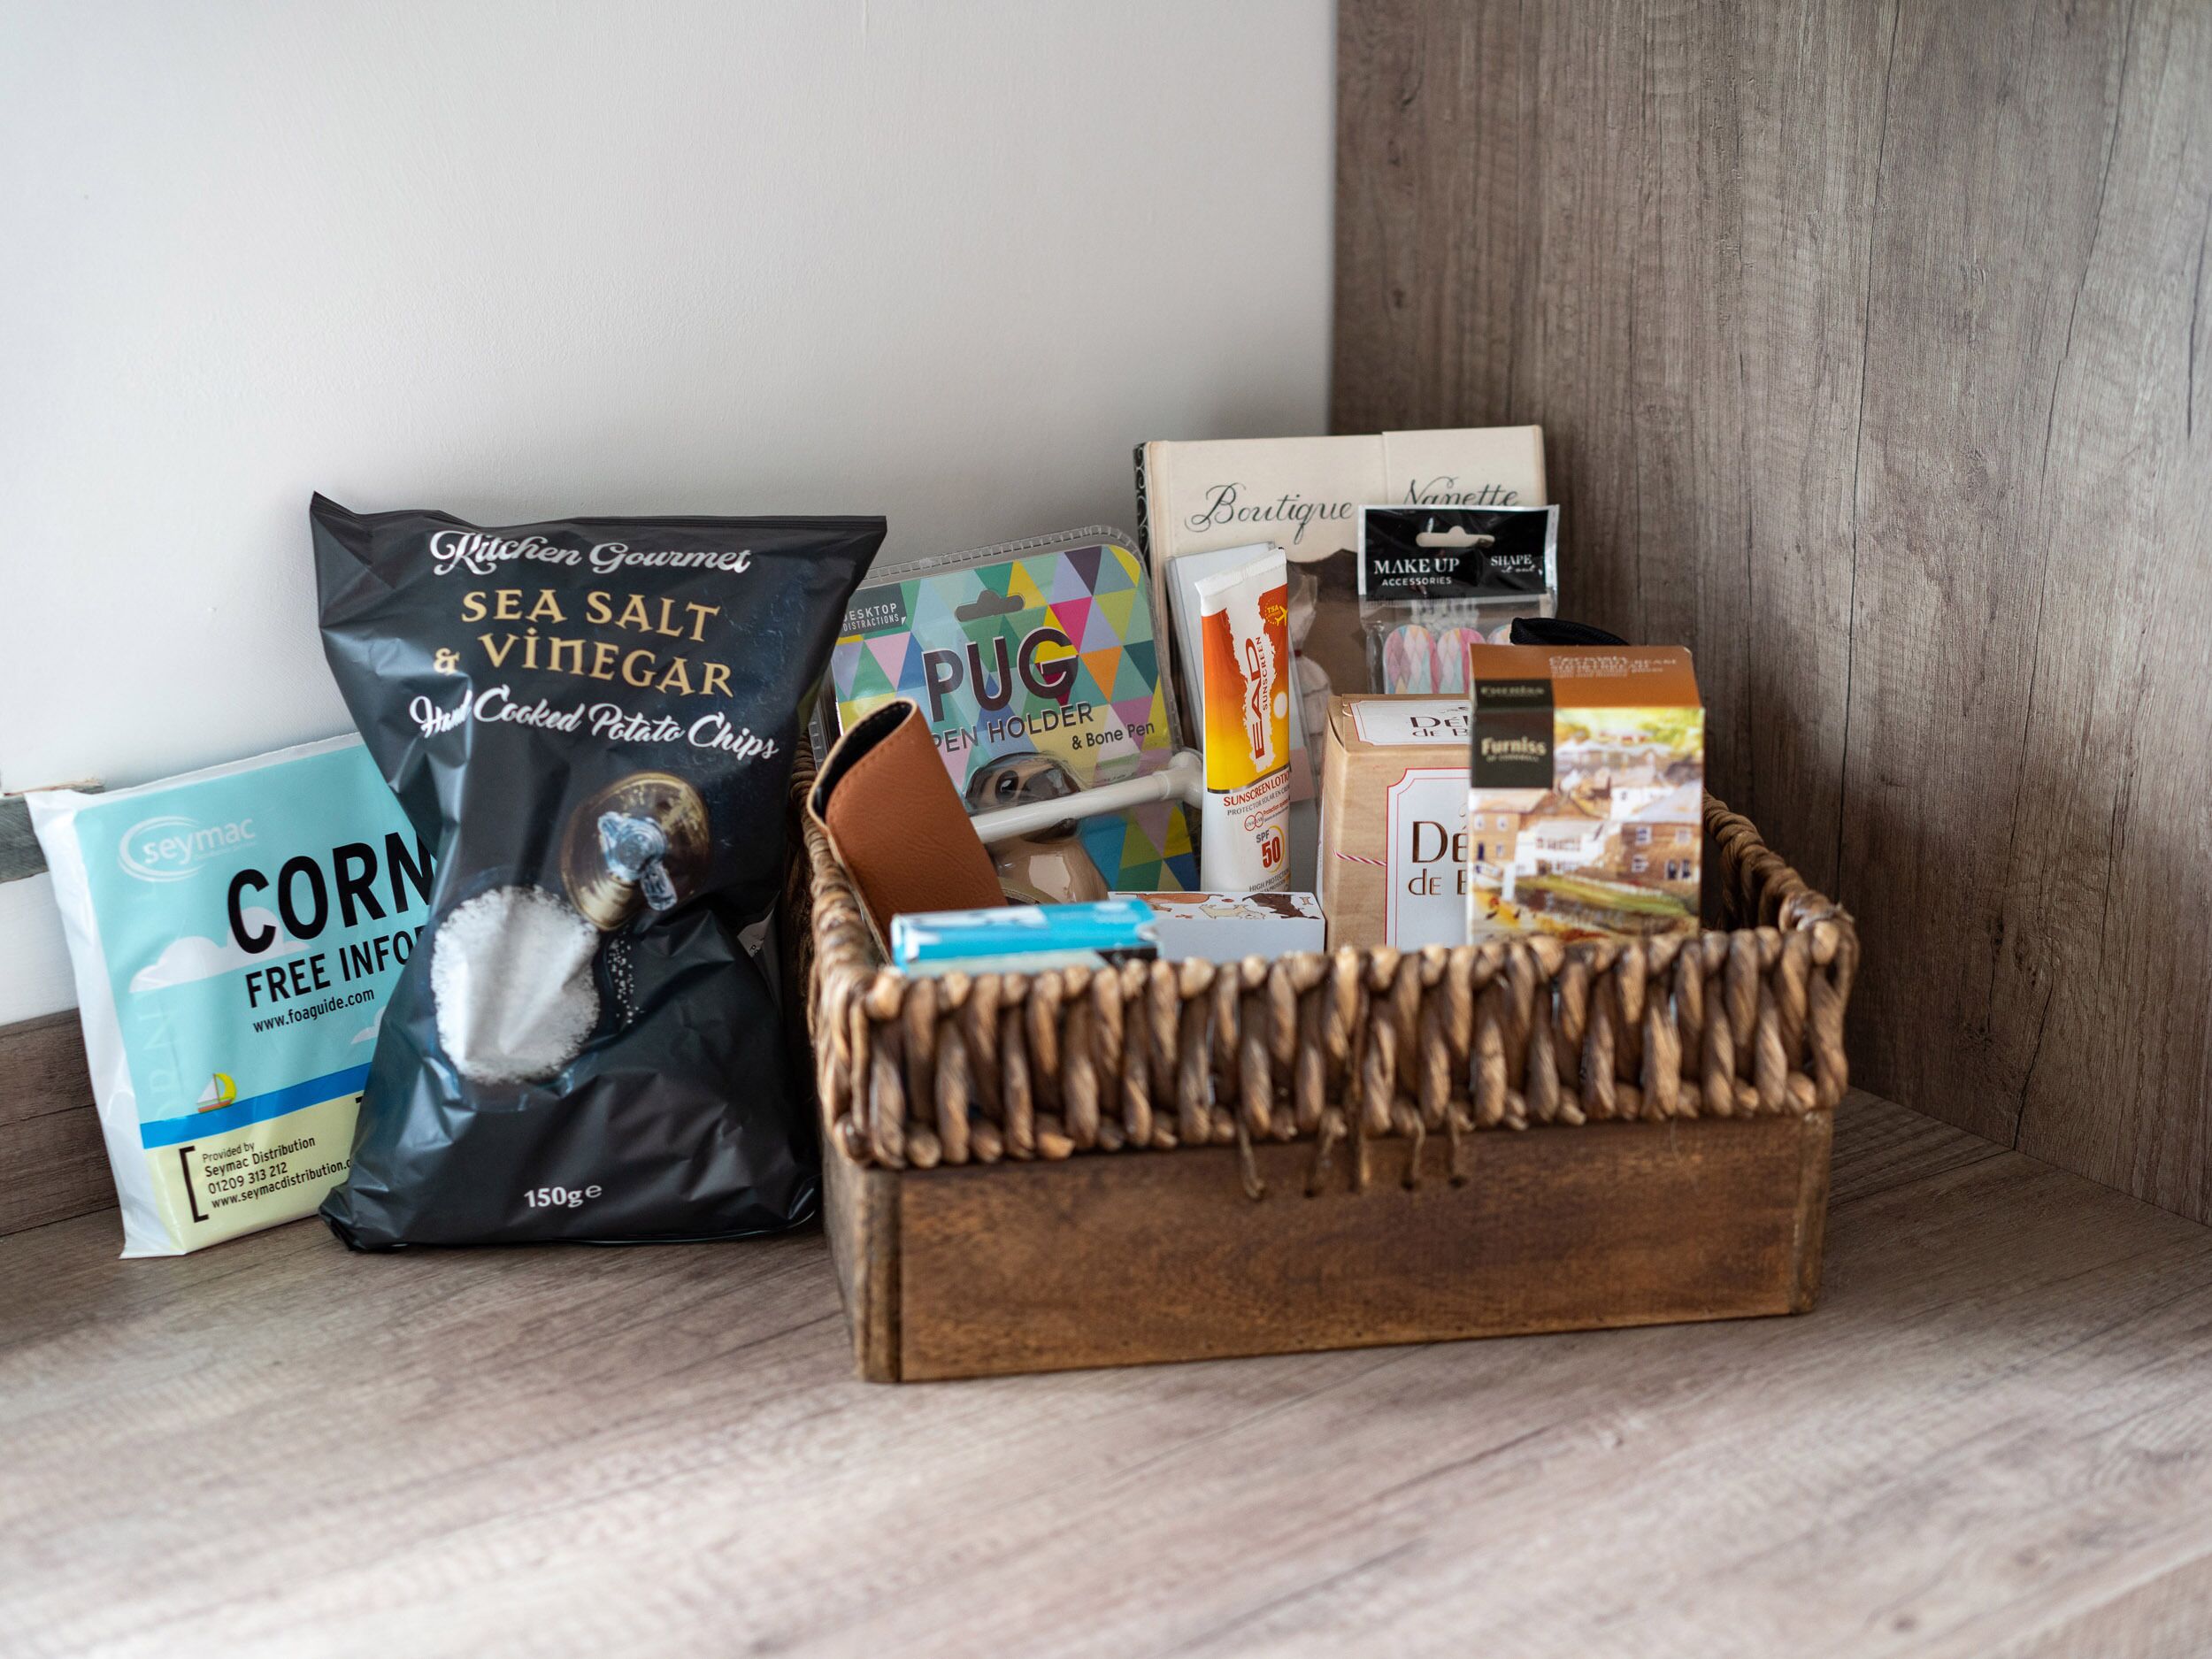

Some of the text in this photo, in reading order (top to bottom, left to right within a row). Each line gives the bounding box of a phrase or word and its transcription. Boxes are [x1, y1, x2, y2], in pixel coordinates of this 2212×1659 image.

[1185, 482, 1353, 545] Boutique
[430, 530, 751, 575] Kitchen Gourmet
[1374, 557, 1460, 574] MAKE UP
[1490, 554, 1532, 566] SHAPE
[1382, 576, 1452, 587] ACCESSORIES
[461, 588, 721, 642] SEA SALT
[842, 613, 899, 632] DISTRACTIONS
[433, 648, 460, 675] &
[921, 626, 1079, 723] PUG
[1256, 636, 1269, 710] SUNSCREEN
[1245, 638, 1265, 759] EAD
[473, 684, 586, 732] Cooked
[588, 703, 686, 742] Potato
[687, 711, 780, 761] Chips
[987, 701, 1094, 744] HOLDER
[1071, 721, 1155, 751] & Bone Pen
[1223, 781, 1271, 807] SUNSCREEN
[1227, 800, 1262, 816] PROTECTOR
[142, 818, 256, 865] seymac
[1256, 830, 1270, 843] SPF
[1261, 836, 1281, 869] 50
[1248, 882, 1265, 892] HIGH
[245, 953, 331, 1009] FREE
[253, 987, 375, 1033] www.foaguide.com
[202, 1141, 255, 1164] Provided by
[204, 1137, 316, 1178] Seymac Distribution
[207, 1161, 288, 1194] 01209 313 212
